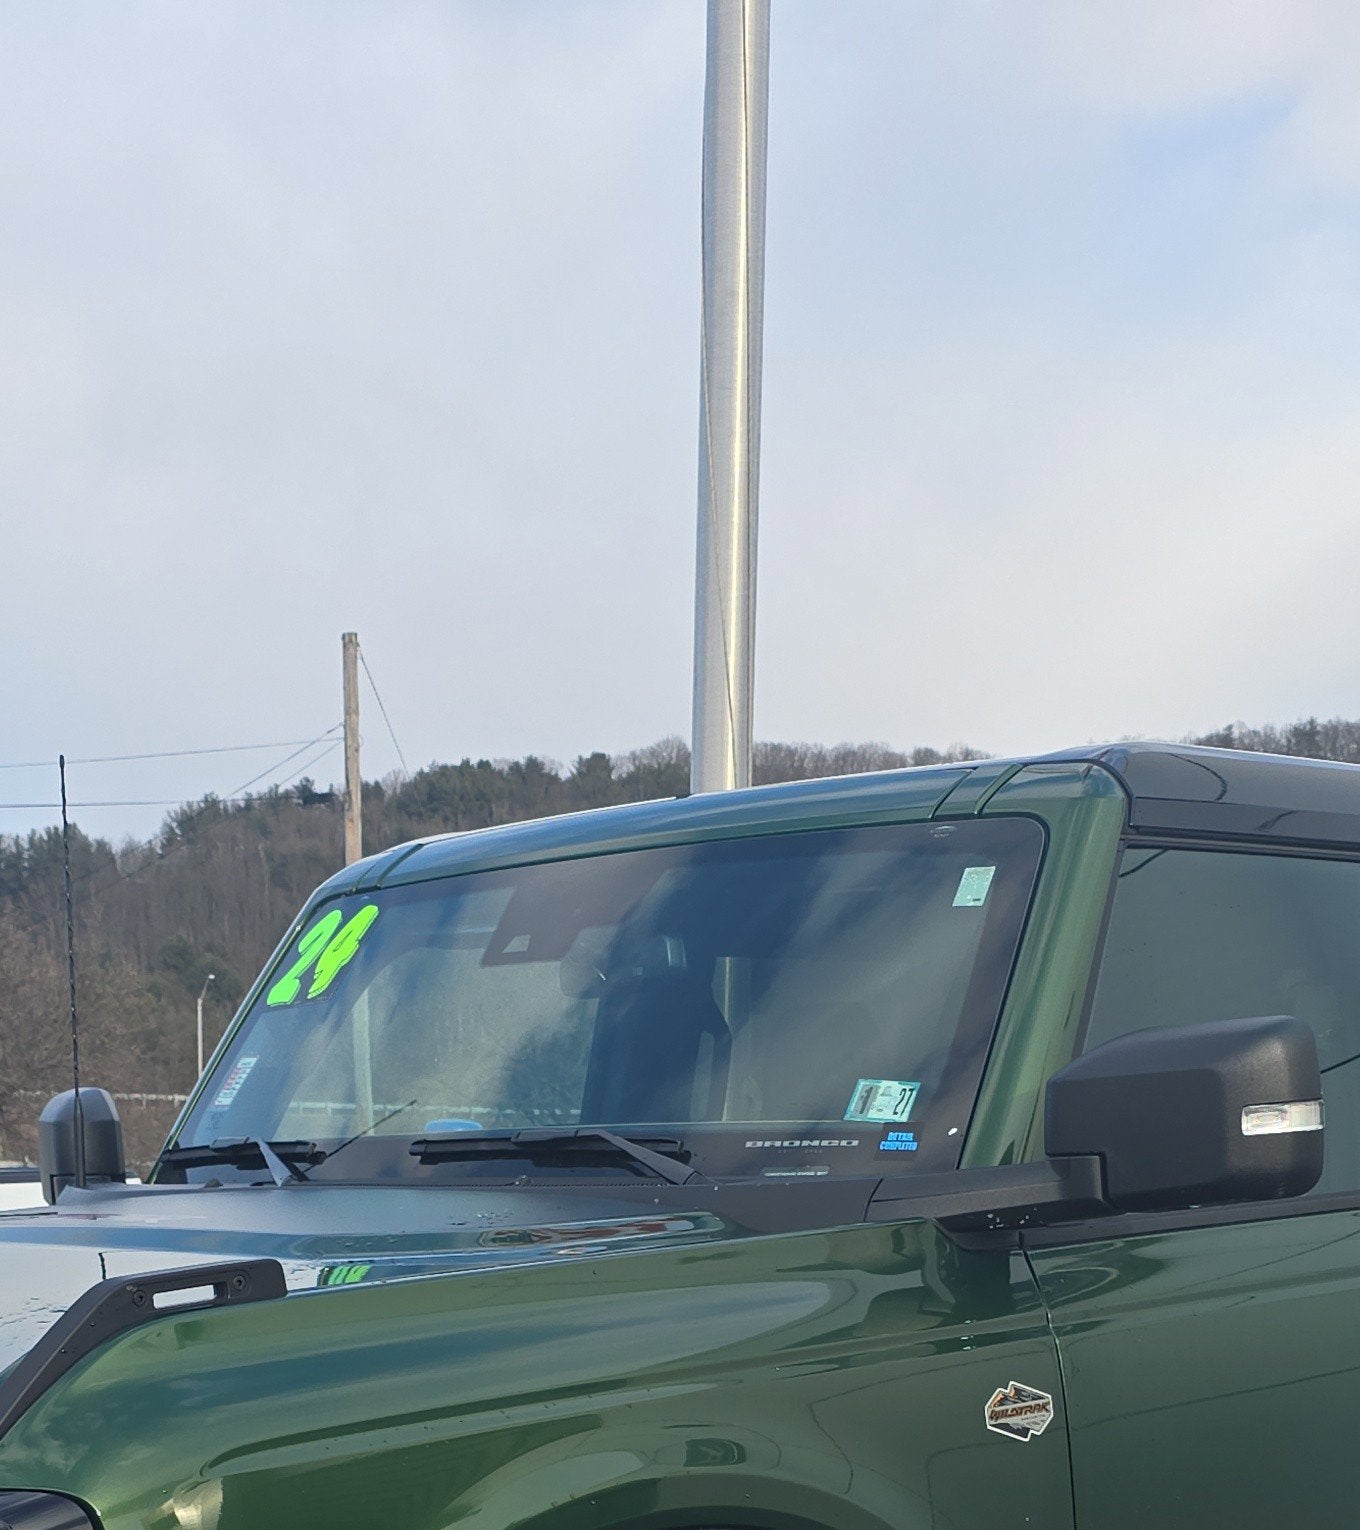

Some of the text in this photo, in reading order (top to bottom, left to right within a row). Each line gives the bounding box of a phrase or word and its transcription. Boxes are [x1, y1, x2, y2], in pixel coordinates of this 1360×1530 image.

[267, 905, 379, 1007] 24
[892, 1087, 916, 1118] 27
[745, 1139, 859, 1149] BRONCO
[990, 1401, 1051, 1422] WILDTRAK
